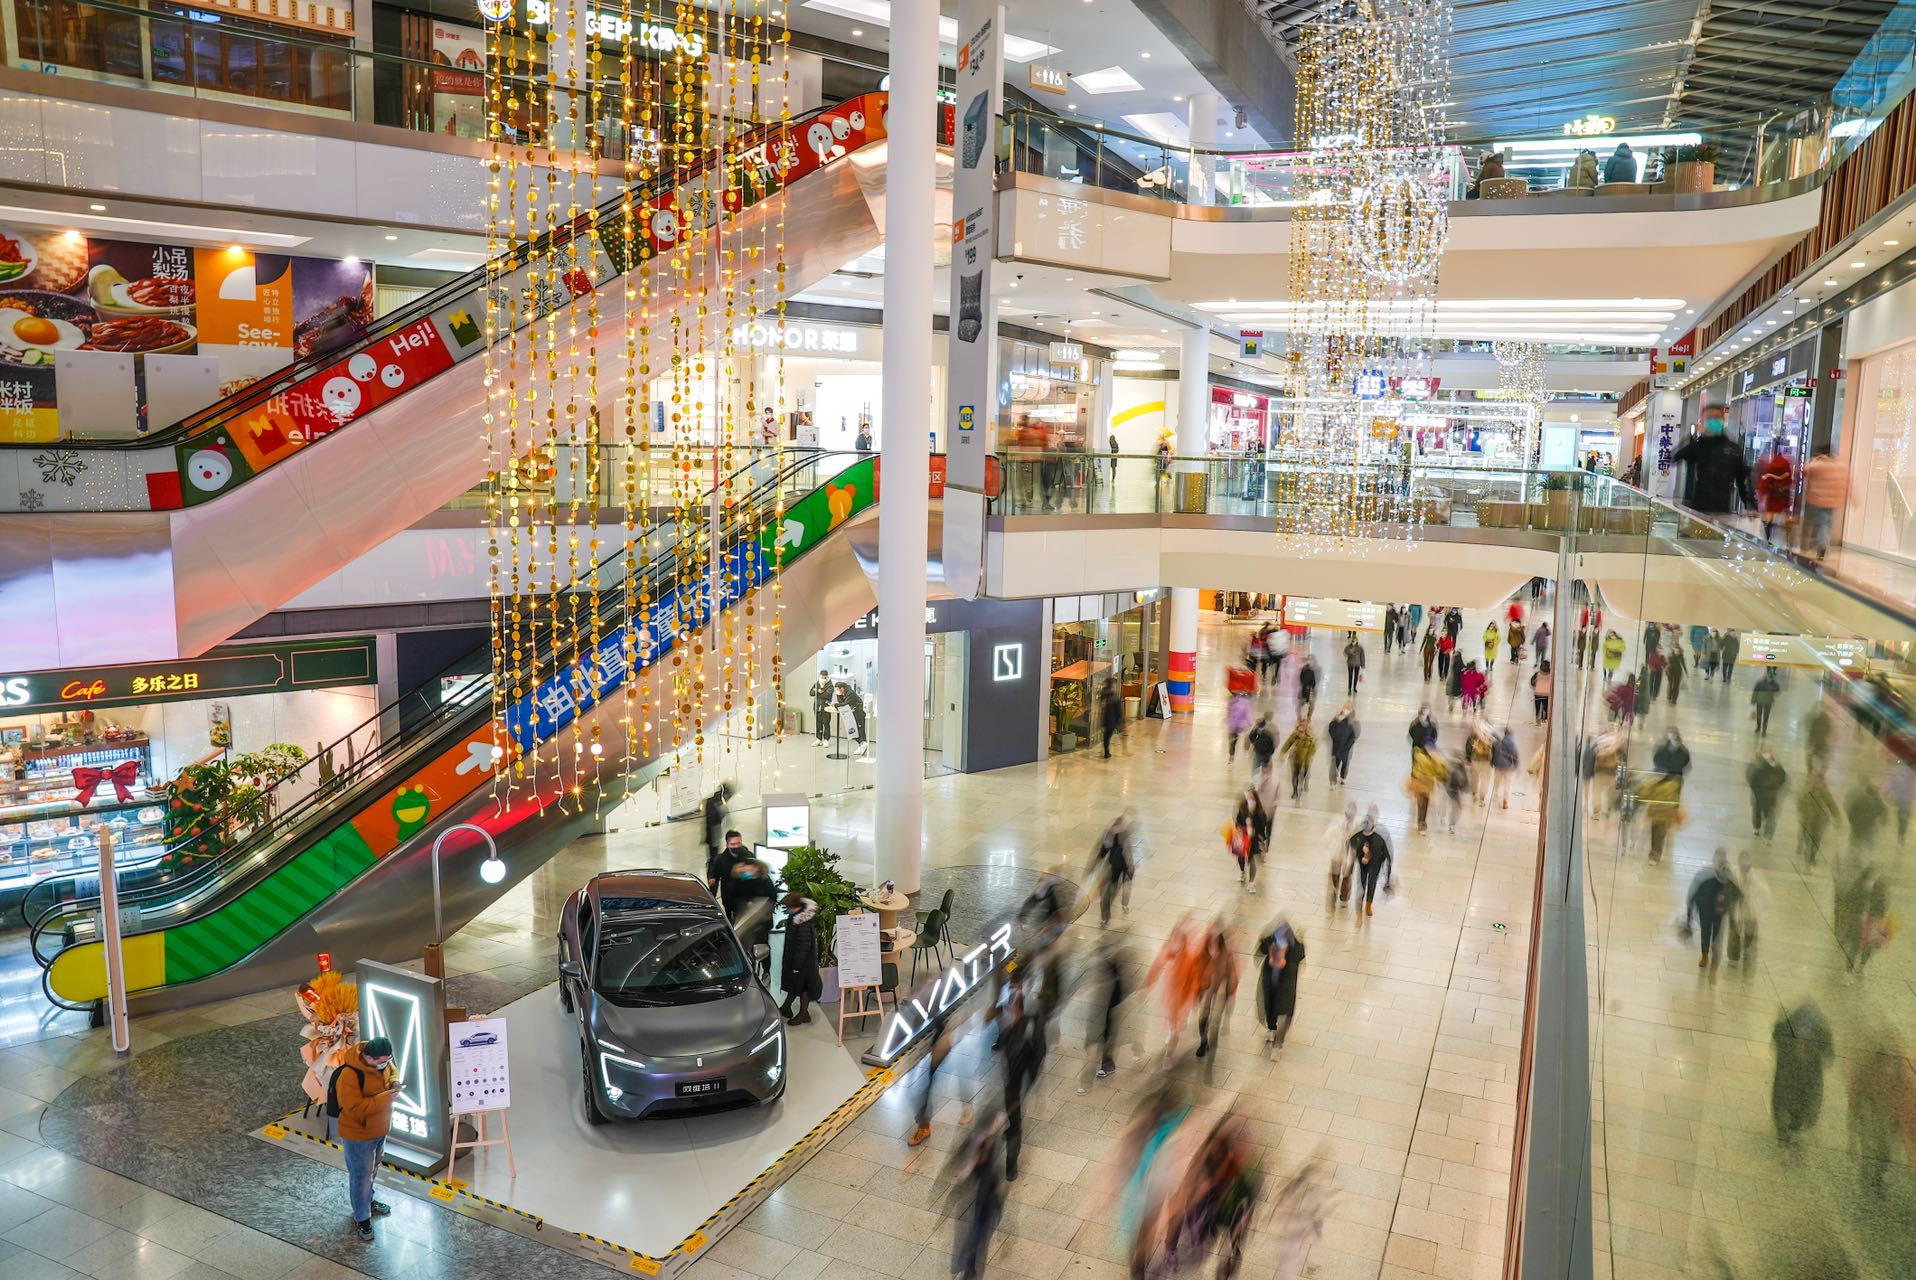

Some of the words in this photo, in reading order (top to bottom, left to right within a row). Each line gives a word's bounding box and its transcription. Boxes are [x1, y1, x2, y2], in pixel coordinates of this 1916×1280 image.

[641, 23, 703, 57] KING
[238, 323, 281, 340] See-
[389, 321, 436, 357] Hej!
[732, 323, 819, 351] HONOR
[1671, 344, 1690, 353] Hej!
[132, 673, 199, 694] 多乐之日
